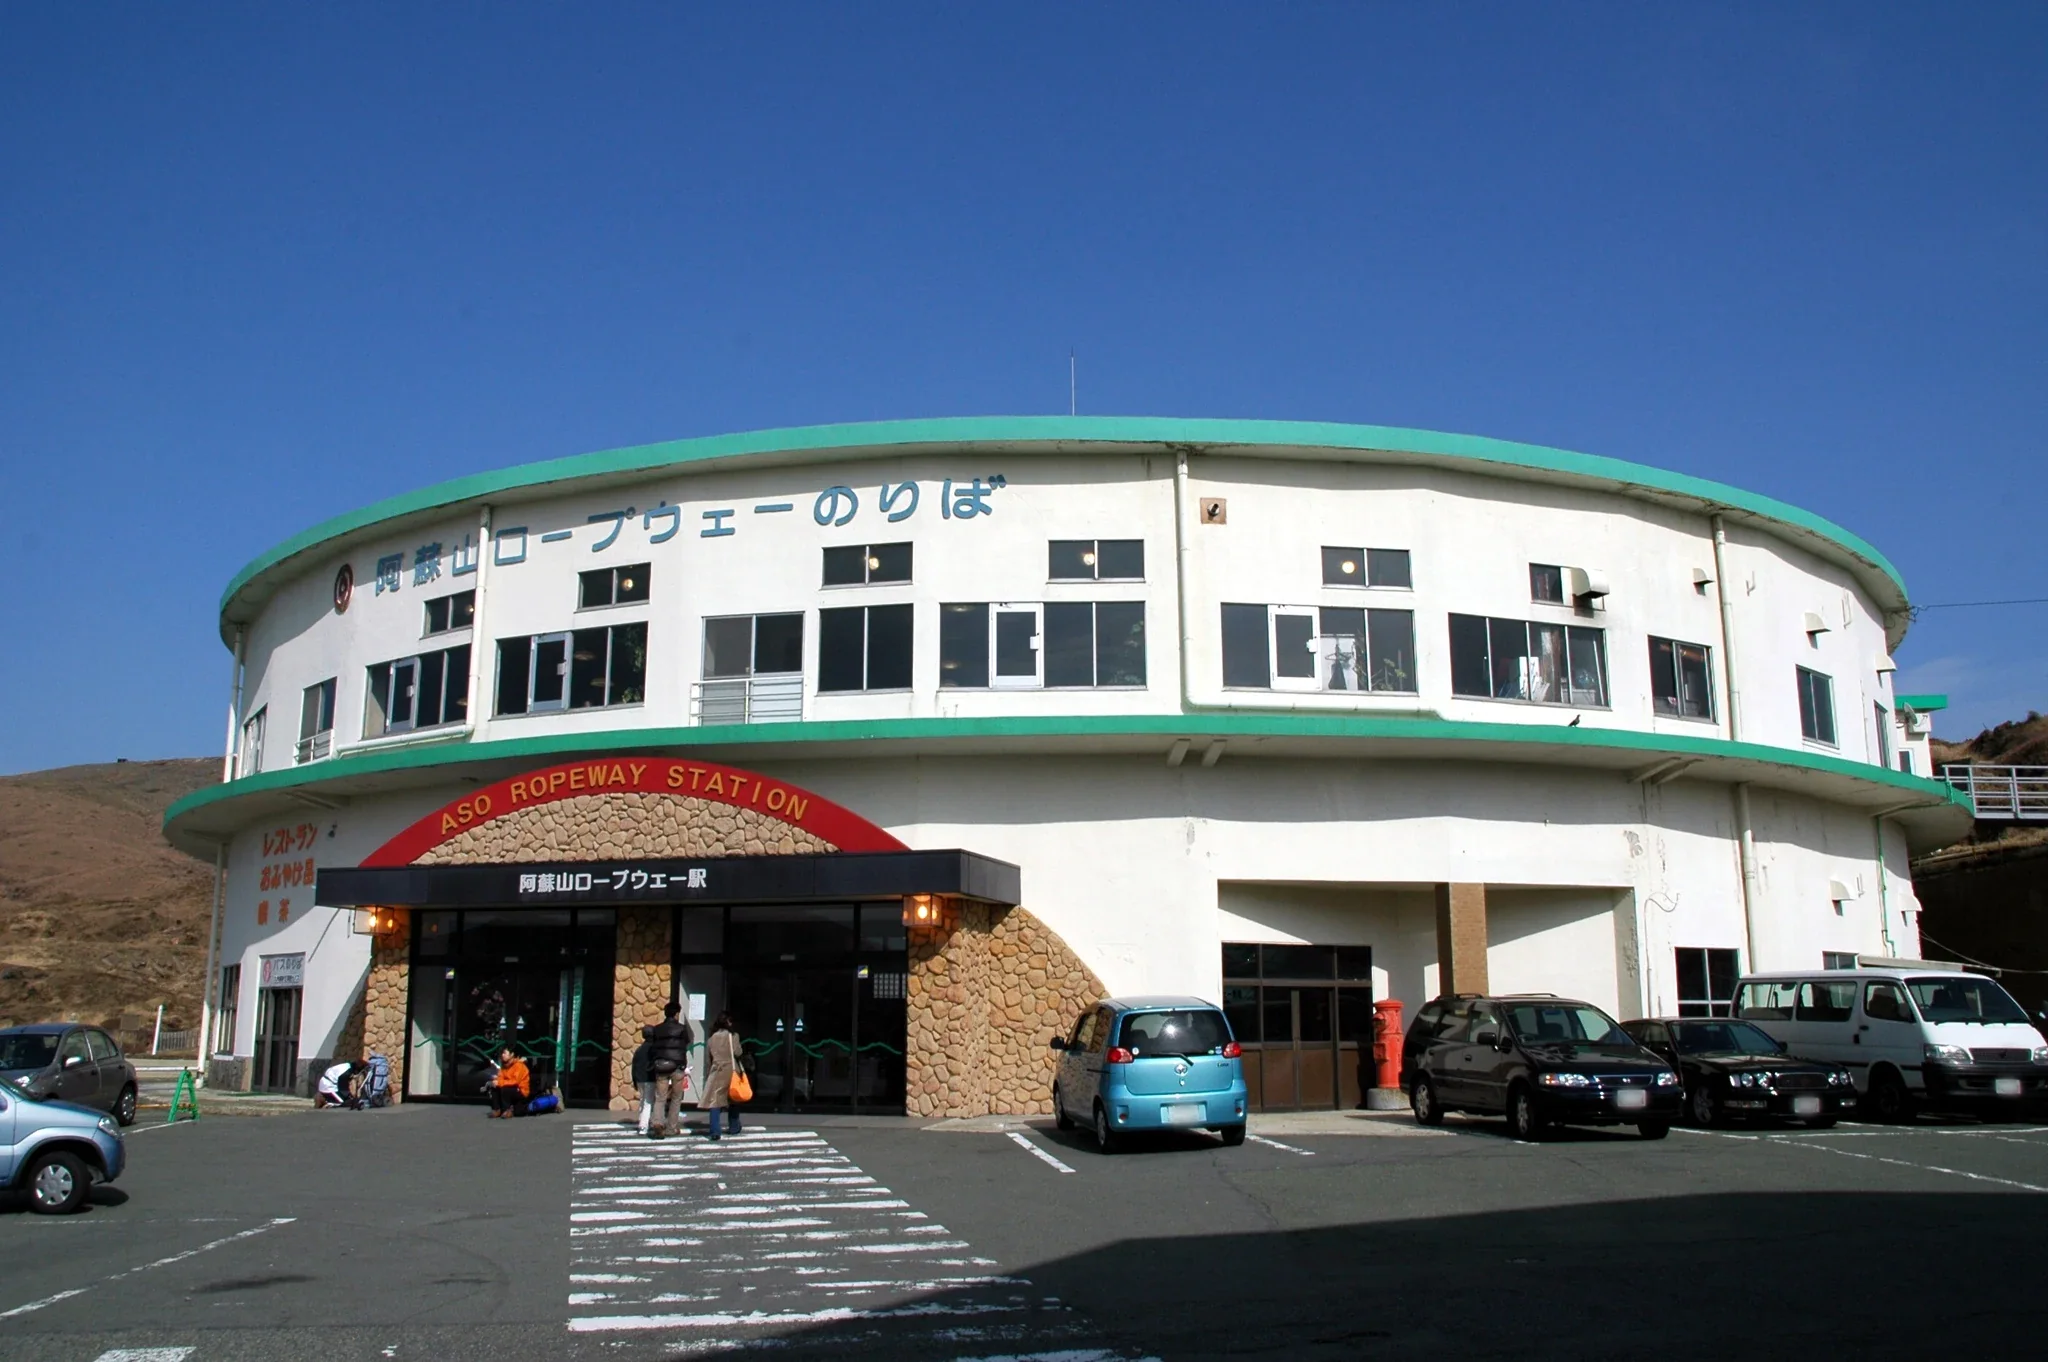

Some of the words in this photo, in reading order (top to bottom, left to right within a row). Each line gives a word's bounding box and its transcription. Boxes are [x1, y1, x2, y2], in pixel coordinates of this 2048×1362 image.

[376, 474, 1007, 597] 阿蘇山ロープウェーのりば
[441, 795, 492, 835] ASO
[510, 763, 647, 804] ROPEWAY
[667, 765, 808, 821] STATION
[263, 823, 318, 858] レストラン
[519, 868, 707, 893] 阿蘇山ロープウェー駅
